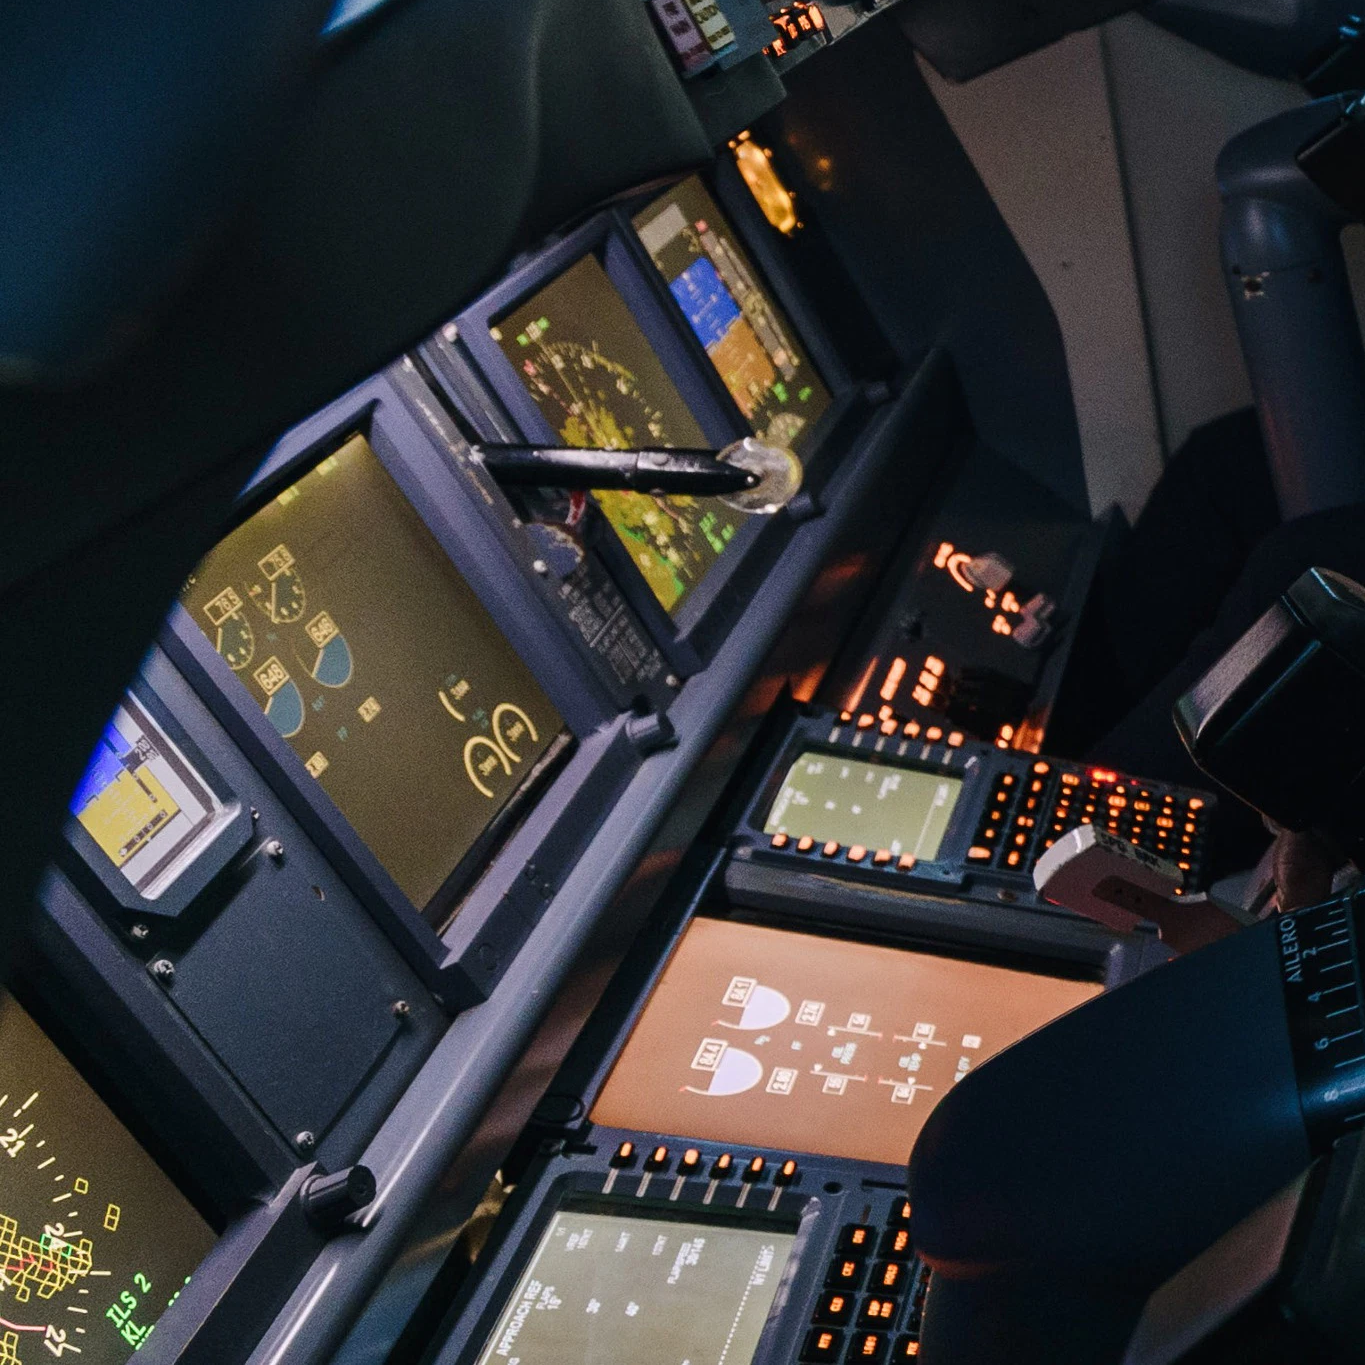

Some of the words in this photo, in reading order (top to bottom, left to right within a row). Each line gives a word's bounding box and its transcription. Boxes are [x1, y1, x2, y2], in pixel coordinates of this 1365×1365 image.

[1279, 913, 1304, 983] AILERO
[1303, 946, 1318, 960] 2
[1307, 991, 1322, 1003] 4
[1314, 1037, 1329, 1051] 6
[0, 1128, 26, 1159] 21
[106, 1291, 138, 1328] ILS
[134, 1272, 151, 1293] 2
[496, 1299, 533, 1357] APPROACH
[524, 1279, 542, 1300] REF
[44, 1325, 66, 1357] 27
